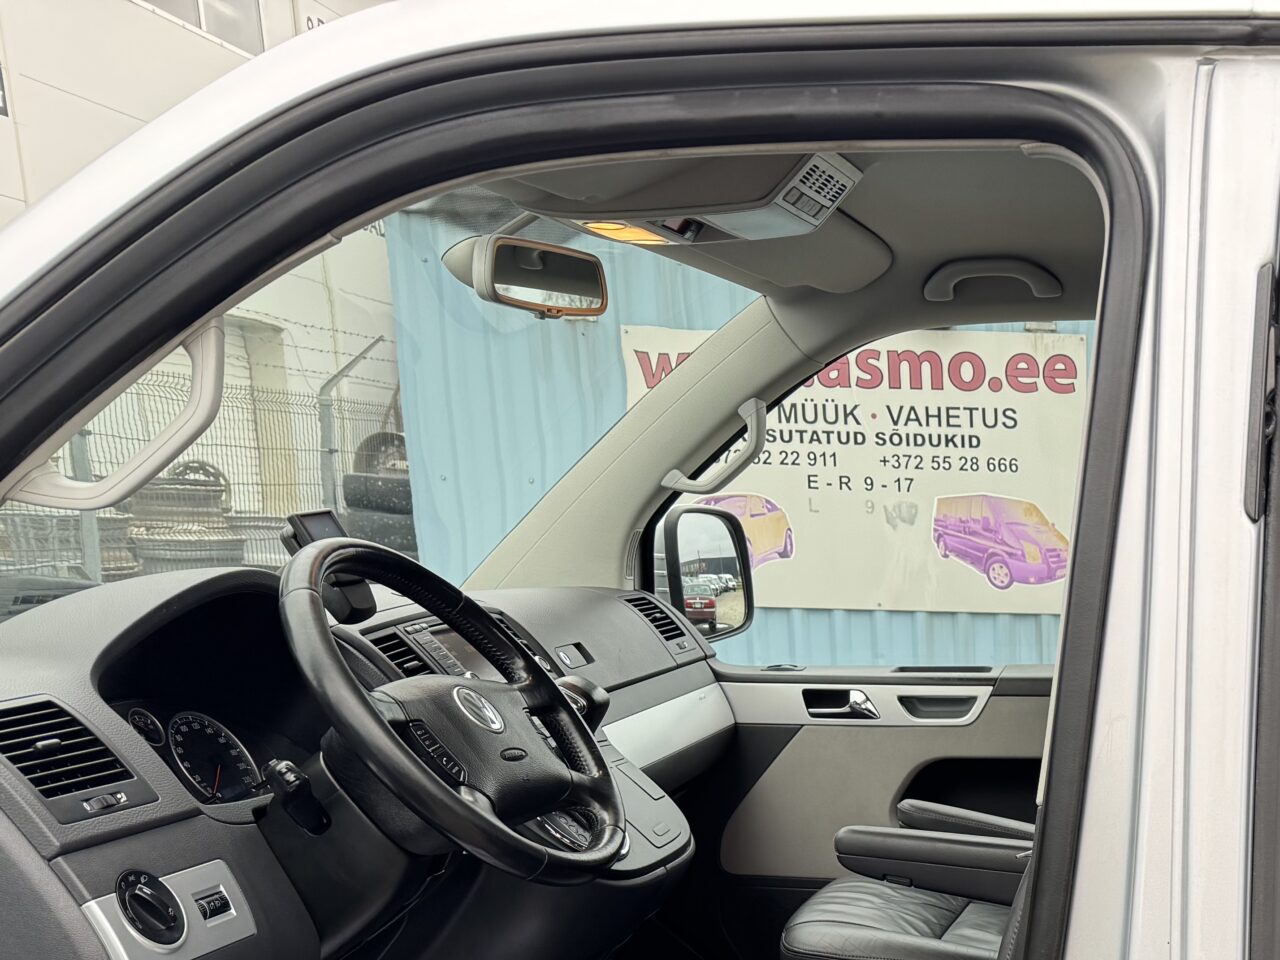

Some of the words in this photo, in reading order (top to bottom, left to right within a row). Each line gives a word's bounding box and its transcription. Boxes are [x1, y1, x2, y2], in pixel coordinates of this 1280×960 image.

[777, 398, 862, 426] MÜÜK
[886, 404, 1018, 430] VAHETUS
[740, 428, 867, 446] SUTATUD
[875, 429, 981, 449] SÕIDUKID
[779, 450, 801, 467] 22
[807, 451, 838, 468] 911
[879, 454, 924, 471] +372
[931, 456, 952, 472] 55
[958, 456, 980, 472] 28
[986, 457, 1019, 474] 666
[808, 474, 820, 490] E
[839, 475, 853, 492] R
[864, 476, 875, 492] 9
[894, 477, 915, 493] 17
